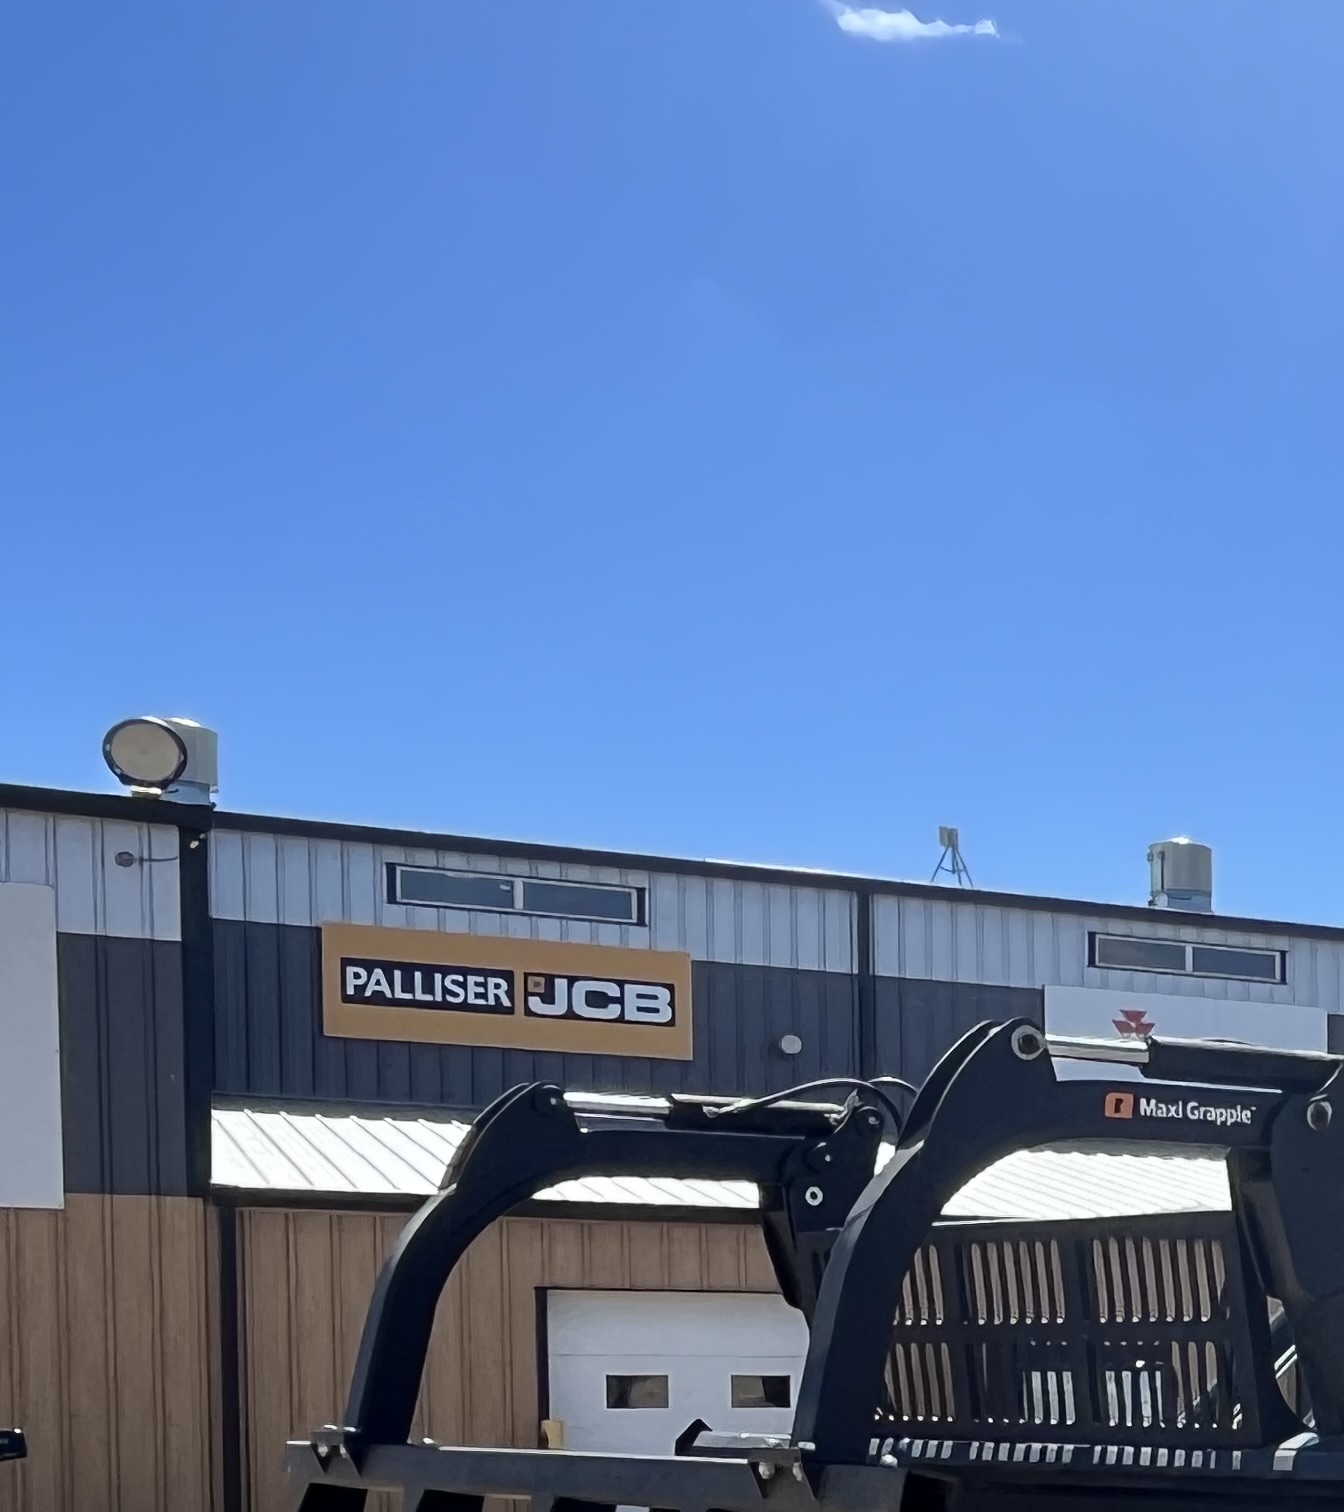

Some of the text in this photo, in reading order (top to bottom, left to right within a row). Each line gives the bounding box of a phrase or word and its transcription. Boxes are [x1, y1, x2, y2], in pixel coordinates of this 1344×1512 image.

[345, 965, 673, 1024] PALLISER JCB
[1139, 1097, 1252, 1126] Maxi Grapple
